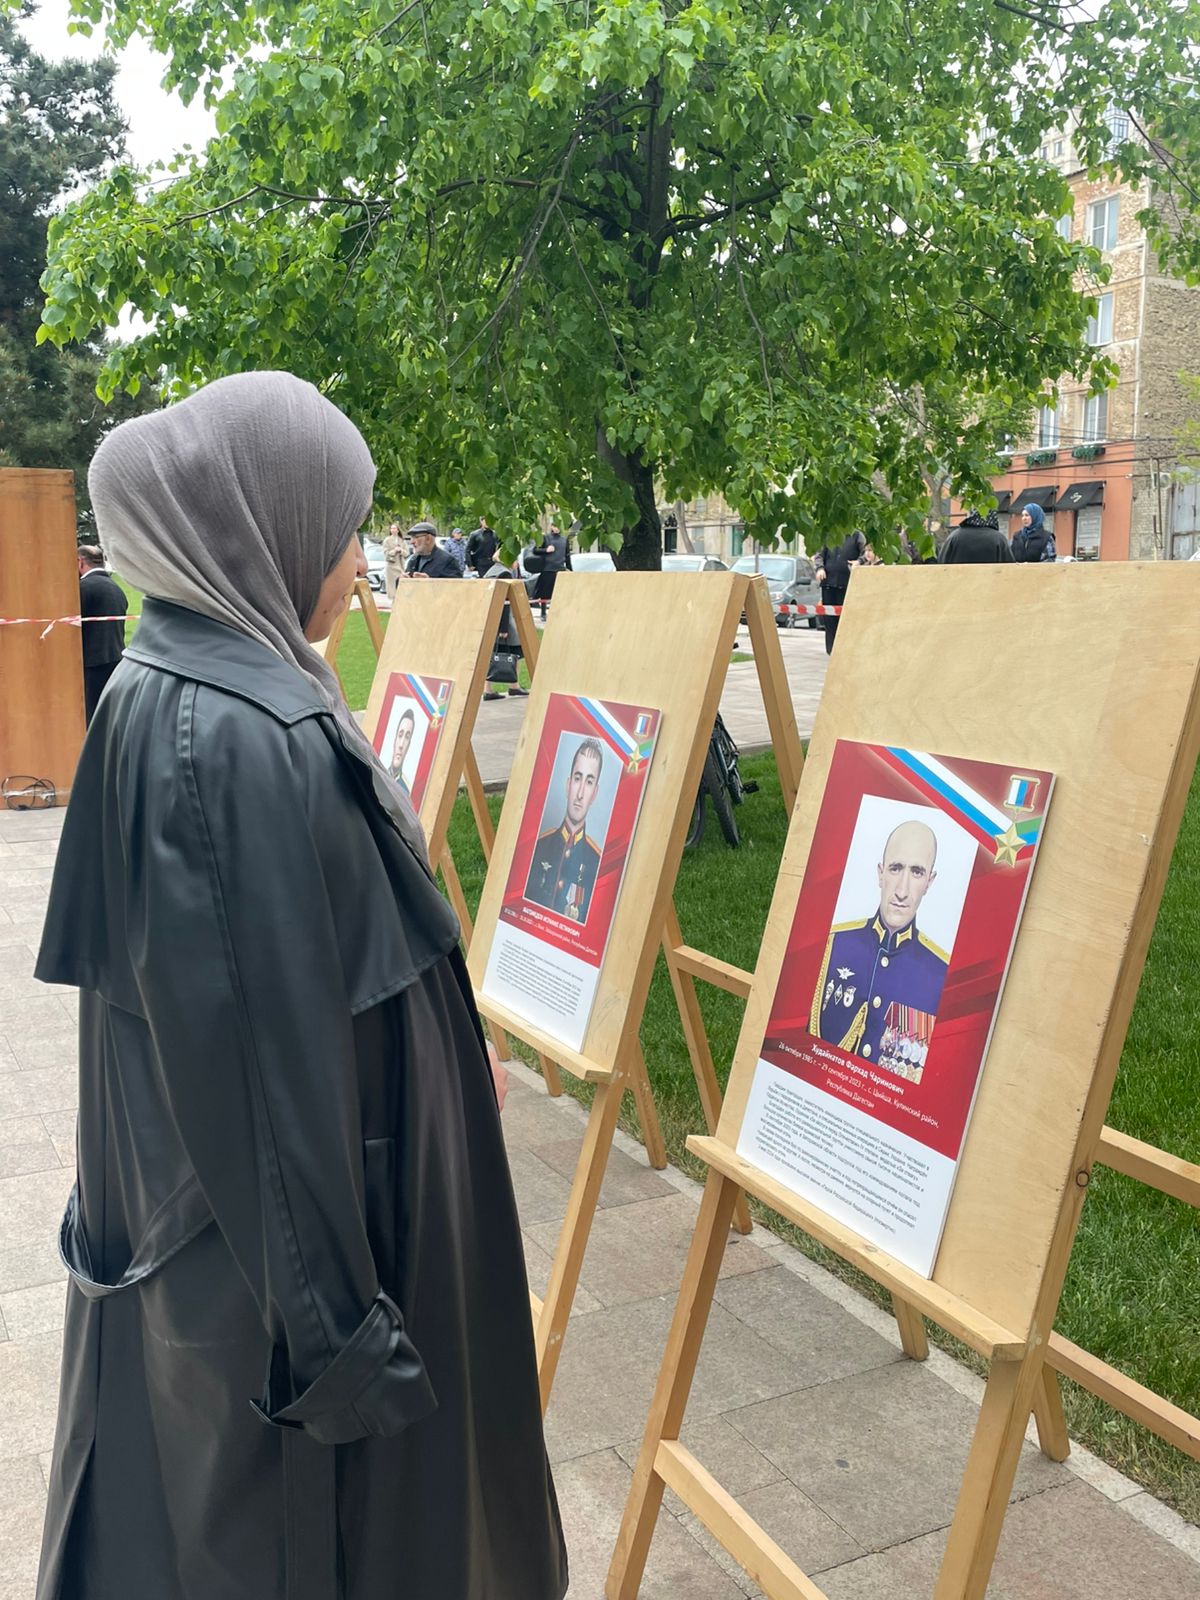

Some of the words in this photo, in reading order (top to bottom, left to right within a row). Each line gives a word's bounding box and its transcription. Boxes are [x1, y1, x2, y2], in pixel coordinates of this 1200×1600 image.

[828, 1067, 849, 1081] сентября
[848, 1076, 861, 1088] 2023
[846, 1060, 868, 1079] Фархад
[870, 1071, 905, 1096] Чаринович
[852, 1092, 875, 1109] Дагестан
